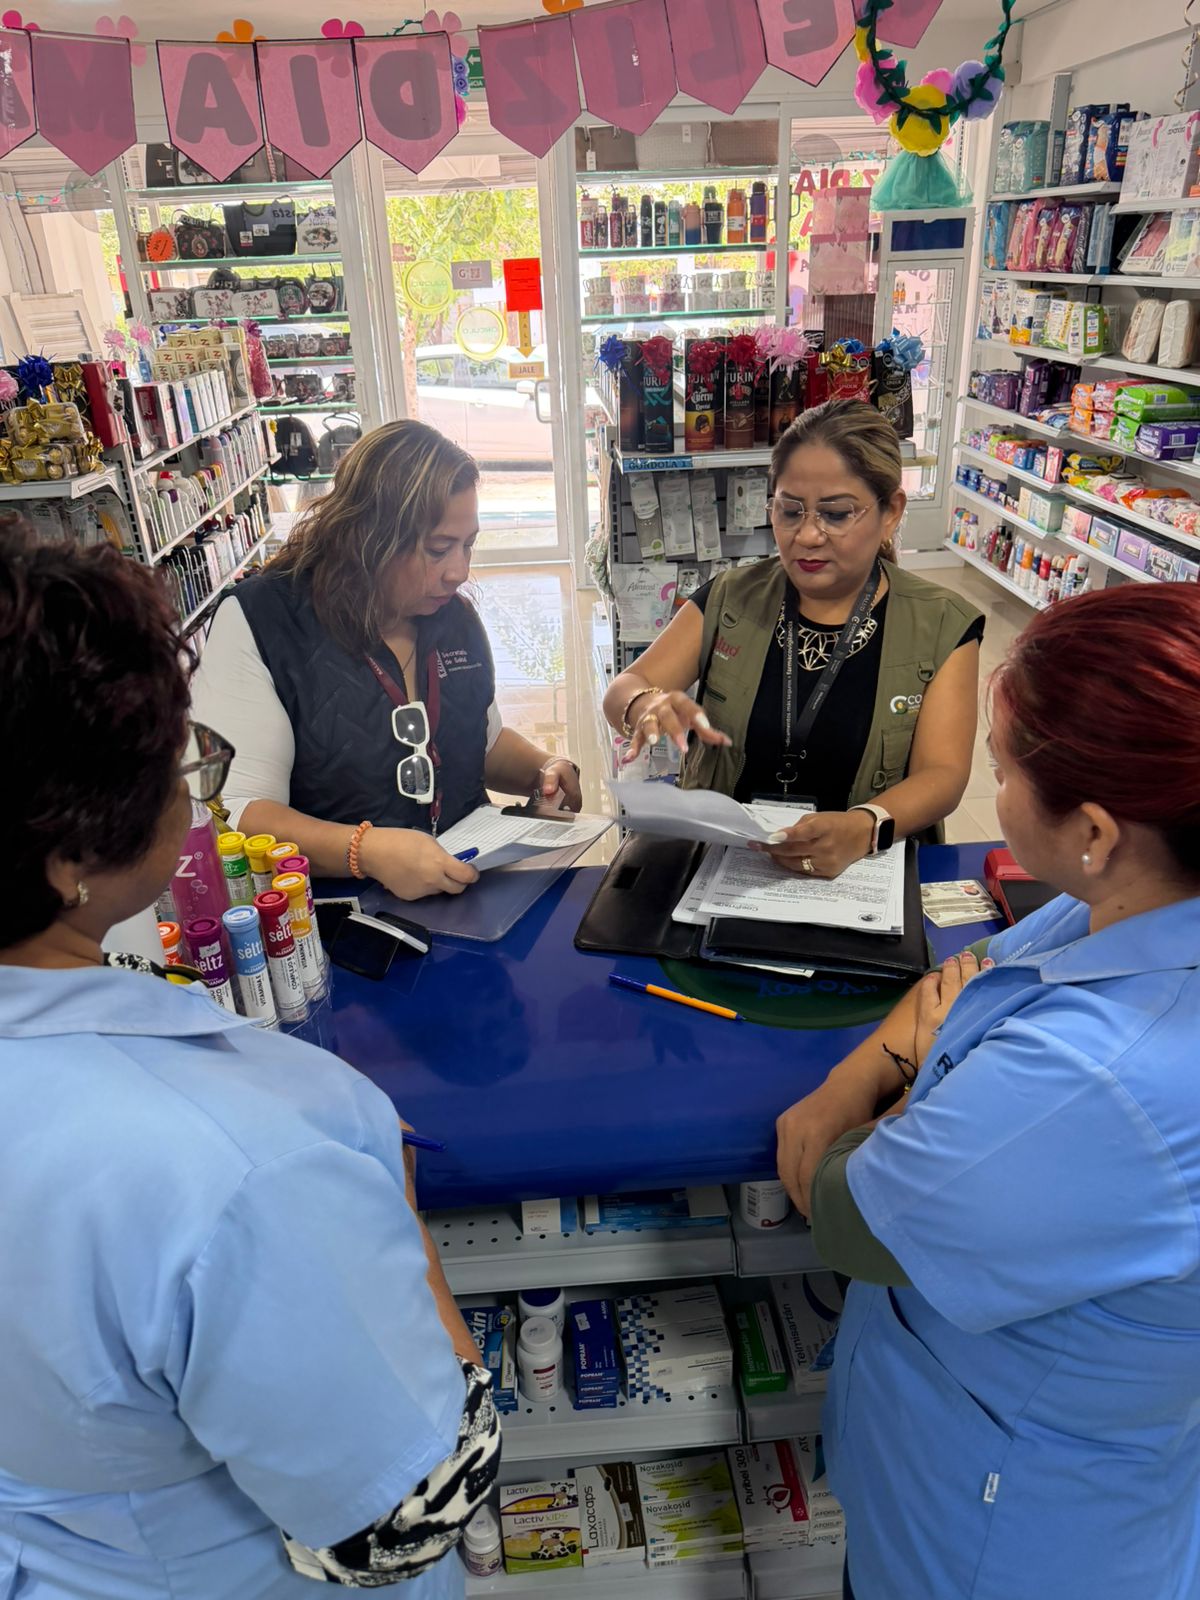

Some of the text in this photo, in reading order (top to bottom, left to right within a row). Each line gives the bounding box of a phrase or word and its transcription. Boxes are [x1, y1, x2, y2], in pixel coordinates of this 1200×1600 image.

[518, 365, 536, 375] JALE
[475, 1310, 488, 1355] exin
[578, 1342, 587, 1369] POPRAM
[640, 1460, 684, 1473] Novakosid
[506, 1486, 530, 1497] Lactiv
[646, 1500, 692, 1514] Novakosid
[513, 1515, 545, 1525] Lactiv
[583, 1485, 599, 1549] Laxacaps
